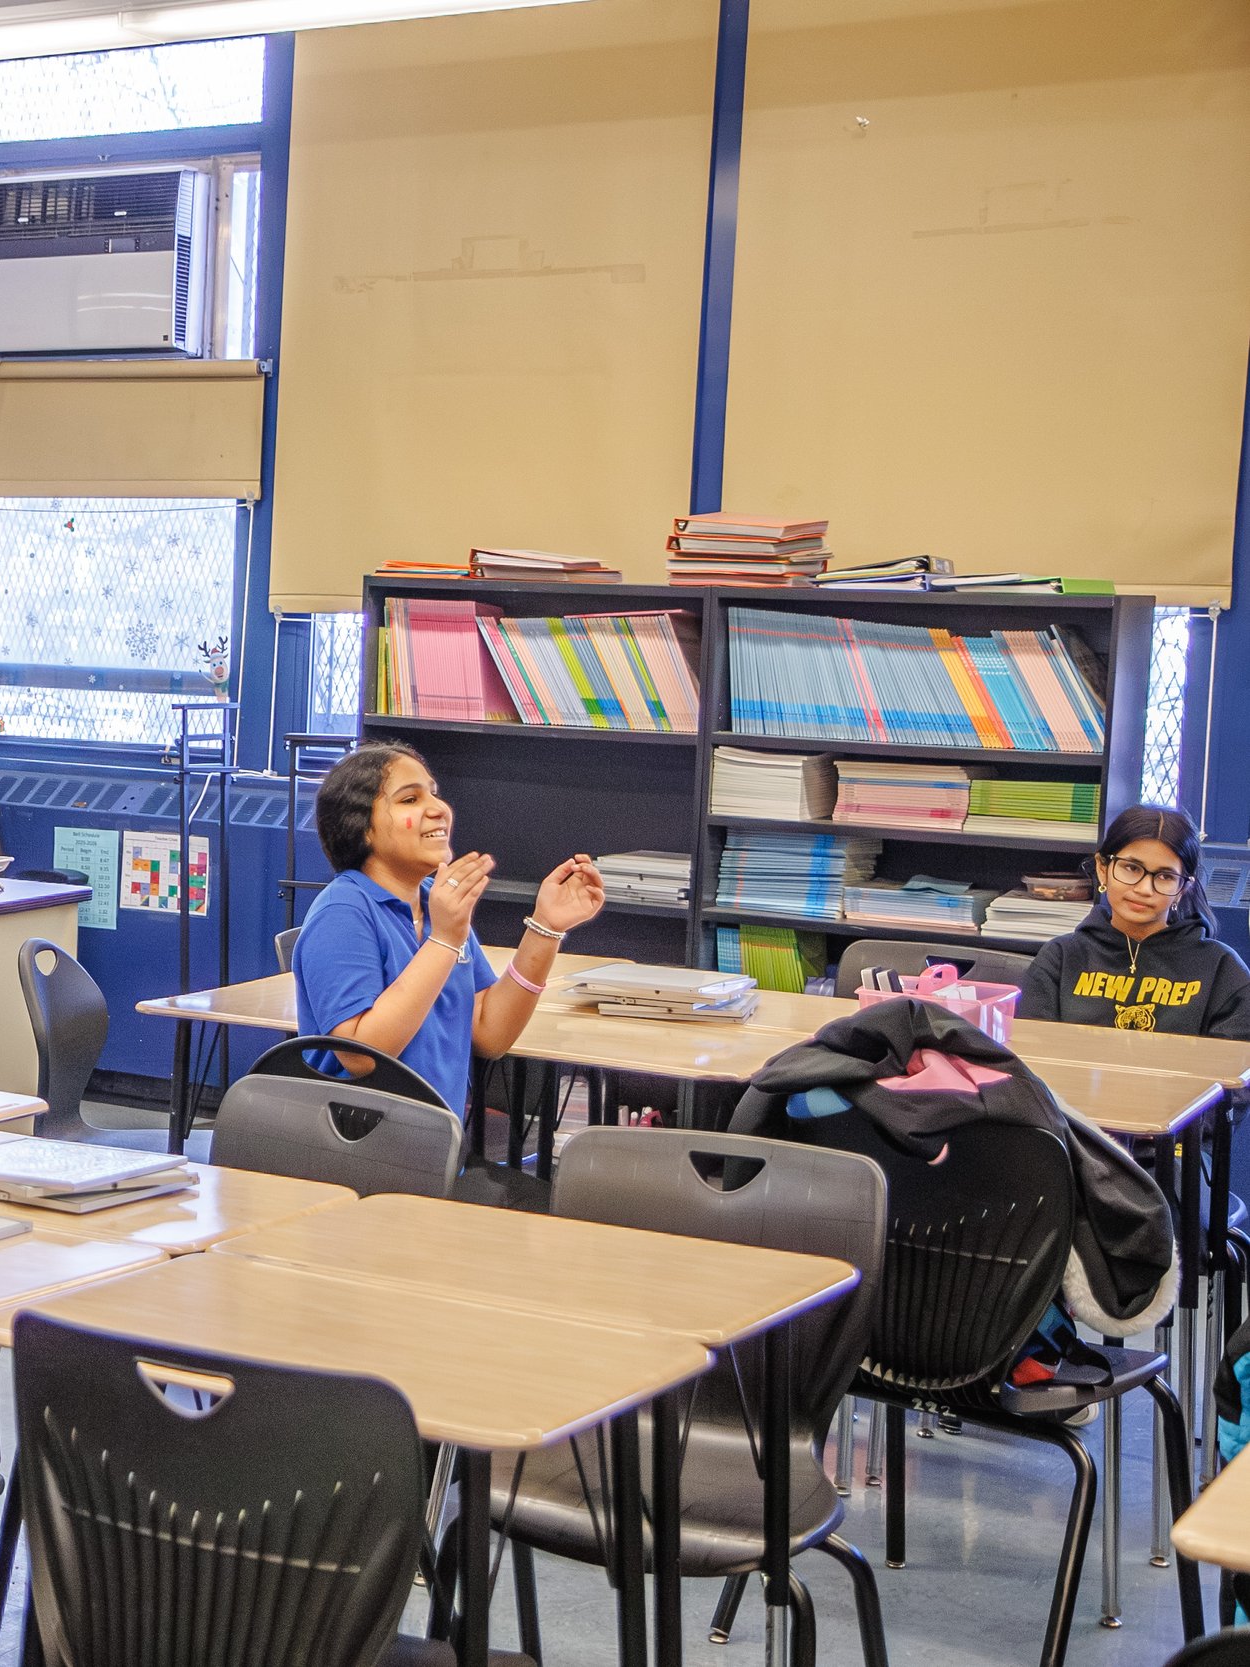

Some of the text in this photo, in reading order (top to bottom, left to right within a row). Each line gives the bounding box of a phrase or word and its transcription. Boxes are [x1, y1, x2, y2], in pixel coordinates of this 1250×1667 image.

[1072, 971, 1202, 1006] NEW PREP
[911, 1397, 957, 1418] 222
